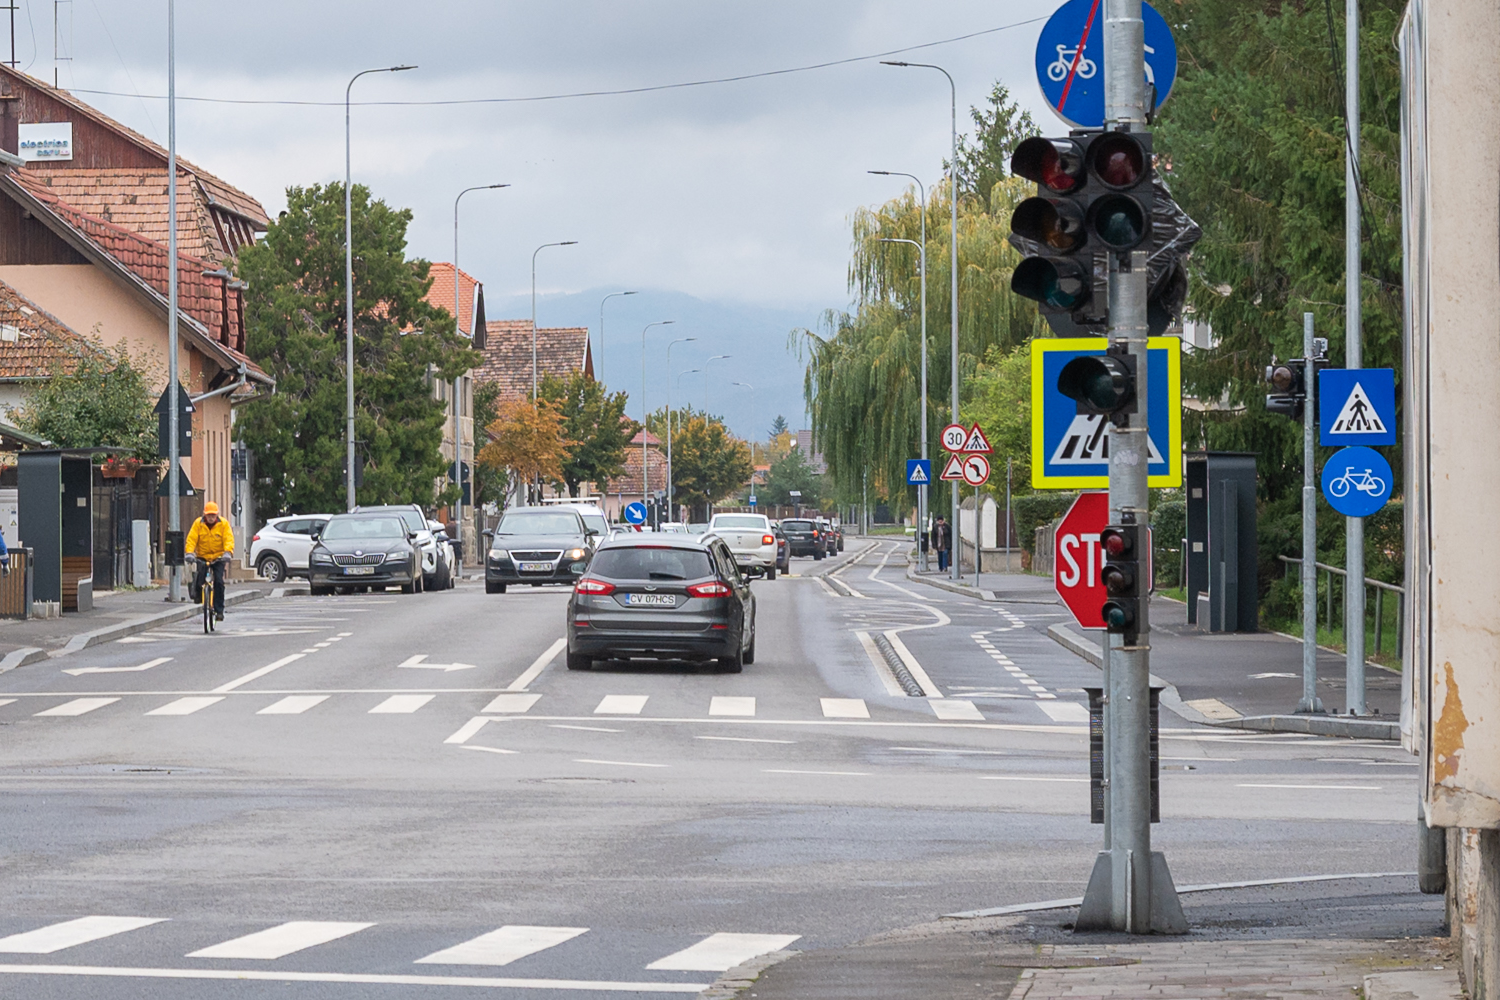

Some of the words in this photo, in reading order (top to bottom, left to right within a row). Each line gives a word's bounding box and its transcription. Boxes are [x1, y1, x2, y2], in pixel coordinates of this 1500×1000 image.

[947, 432, 962, 445] 30
[1060, 533, 1107, 588] ST
[630, 594, 643, 603] CV
[645, 595, 674, 604] 07HCS
